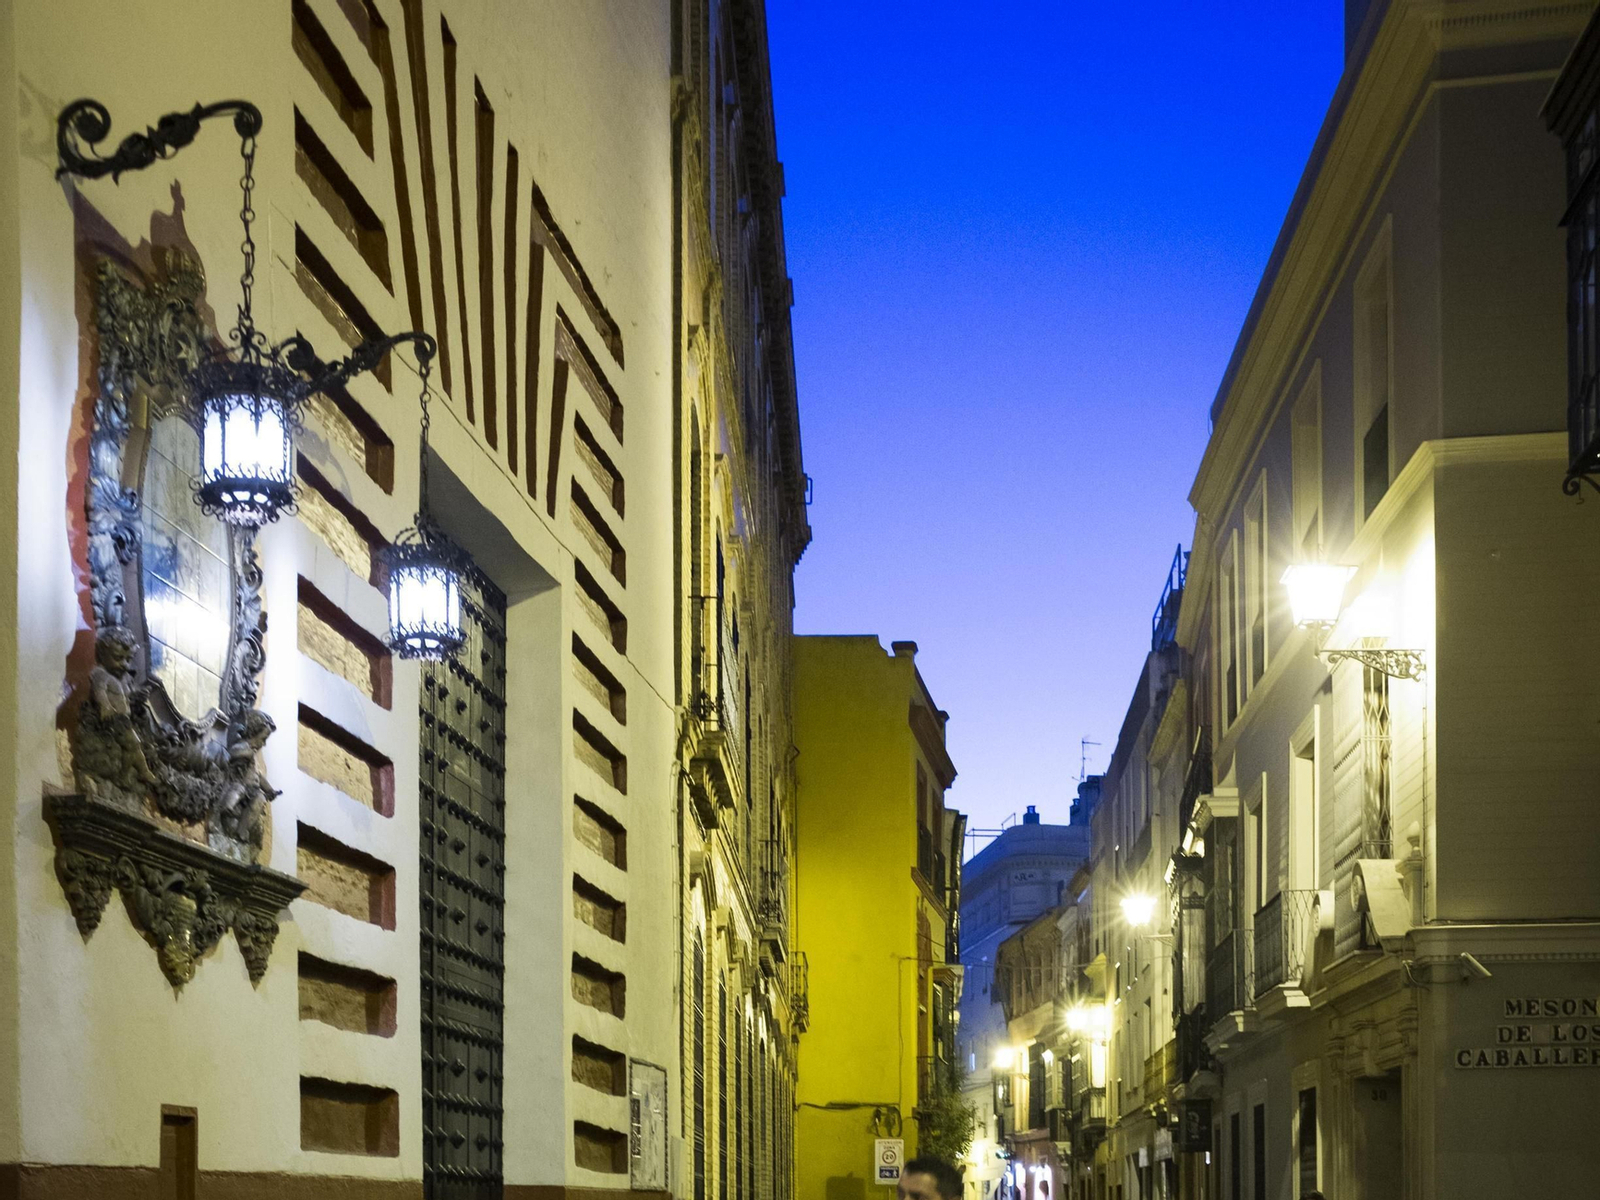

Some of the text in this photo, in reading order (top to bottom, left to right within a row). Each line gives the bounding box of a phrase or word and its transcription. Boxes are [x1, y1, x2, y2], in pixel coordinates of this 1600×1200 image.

[1505, 1000, 1597, 1016] MESON
[1498, 1025, 1600, 1043] DE LOS
